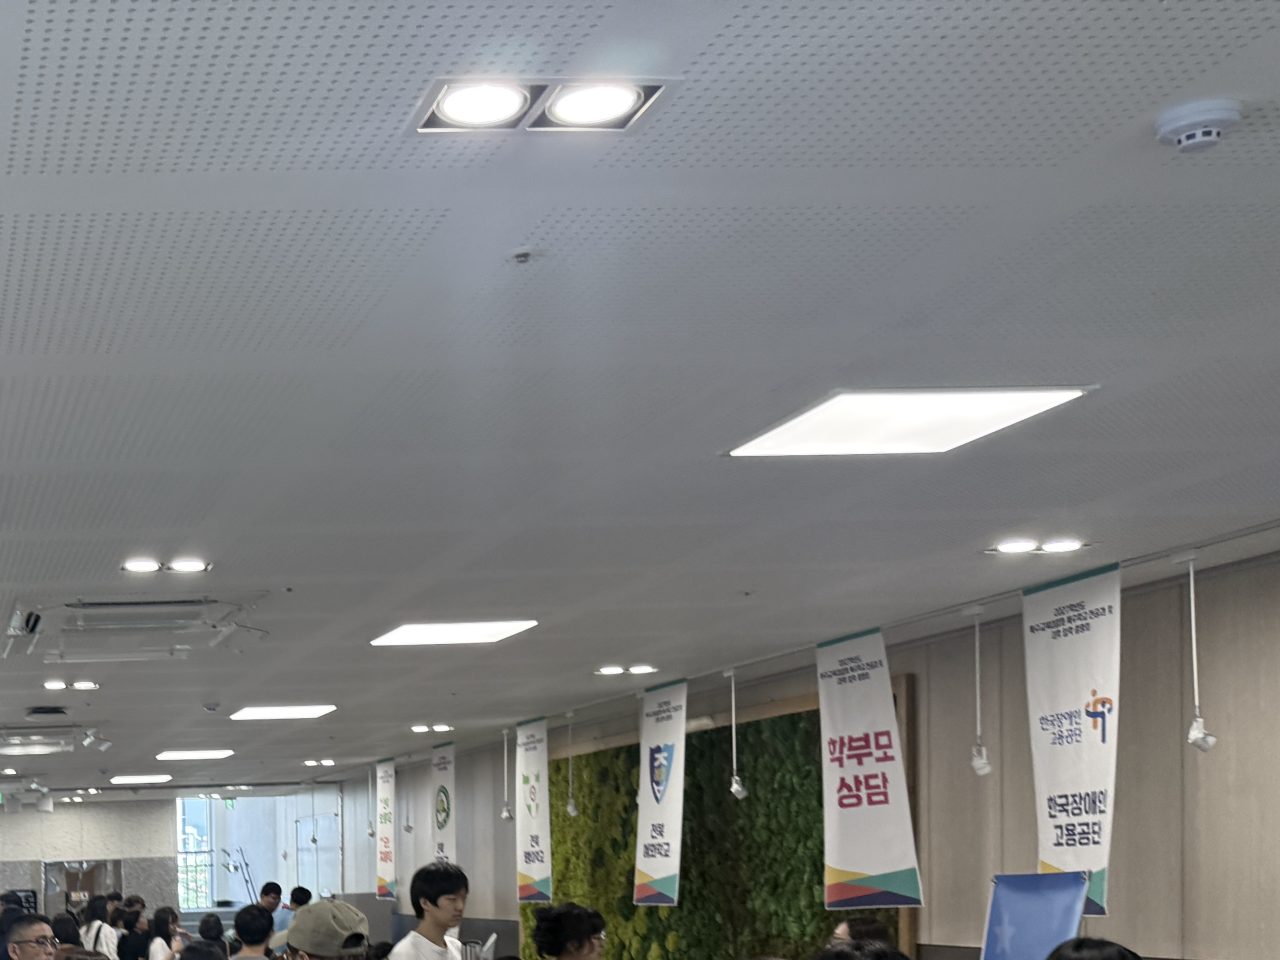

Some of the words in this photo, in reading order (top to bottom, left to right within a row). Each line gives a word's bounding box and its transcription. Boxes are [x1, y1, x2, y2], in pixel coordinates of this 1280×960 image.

[1039, 709, 1082, 731] 한국장애인
[827, 730, 896, 768] 학부모
[1050, 727, 1083, 746] 고용공단
[837, 771, 890, 809] 상담
[1047, 789, 1108, 818] 한국장애인
[1053, 820, 1102, 846] 고용공단
